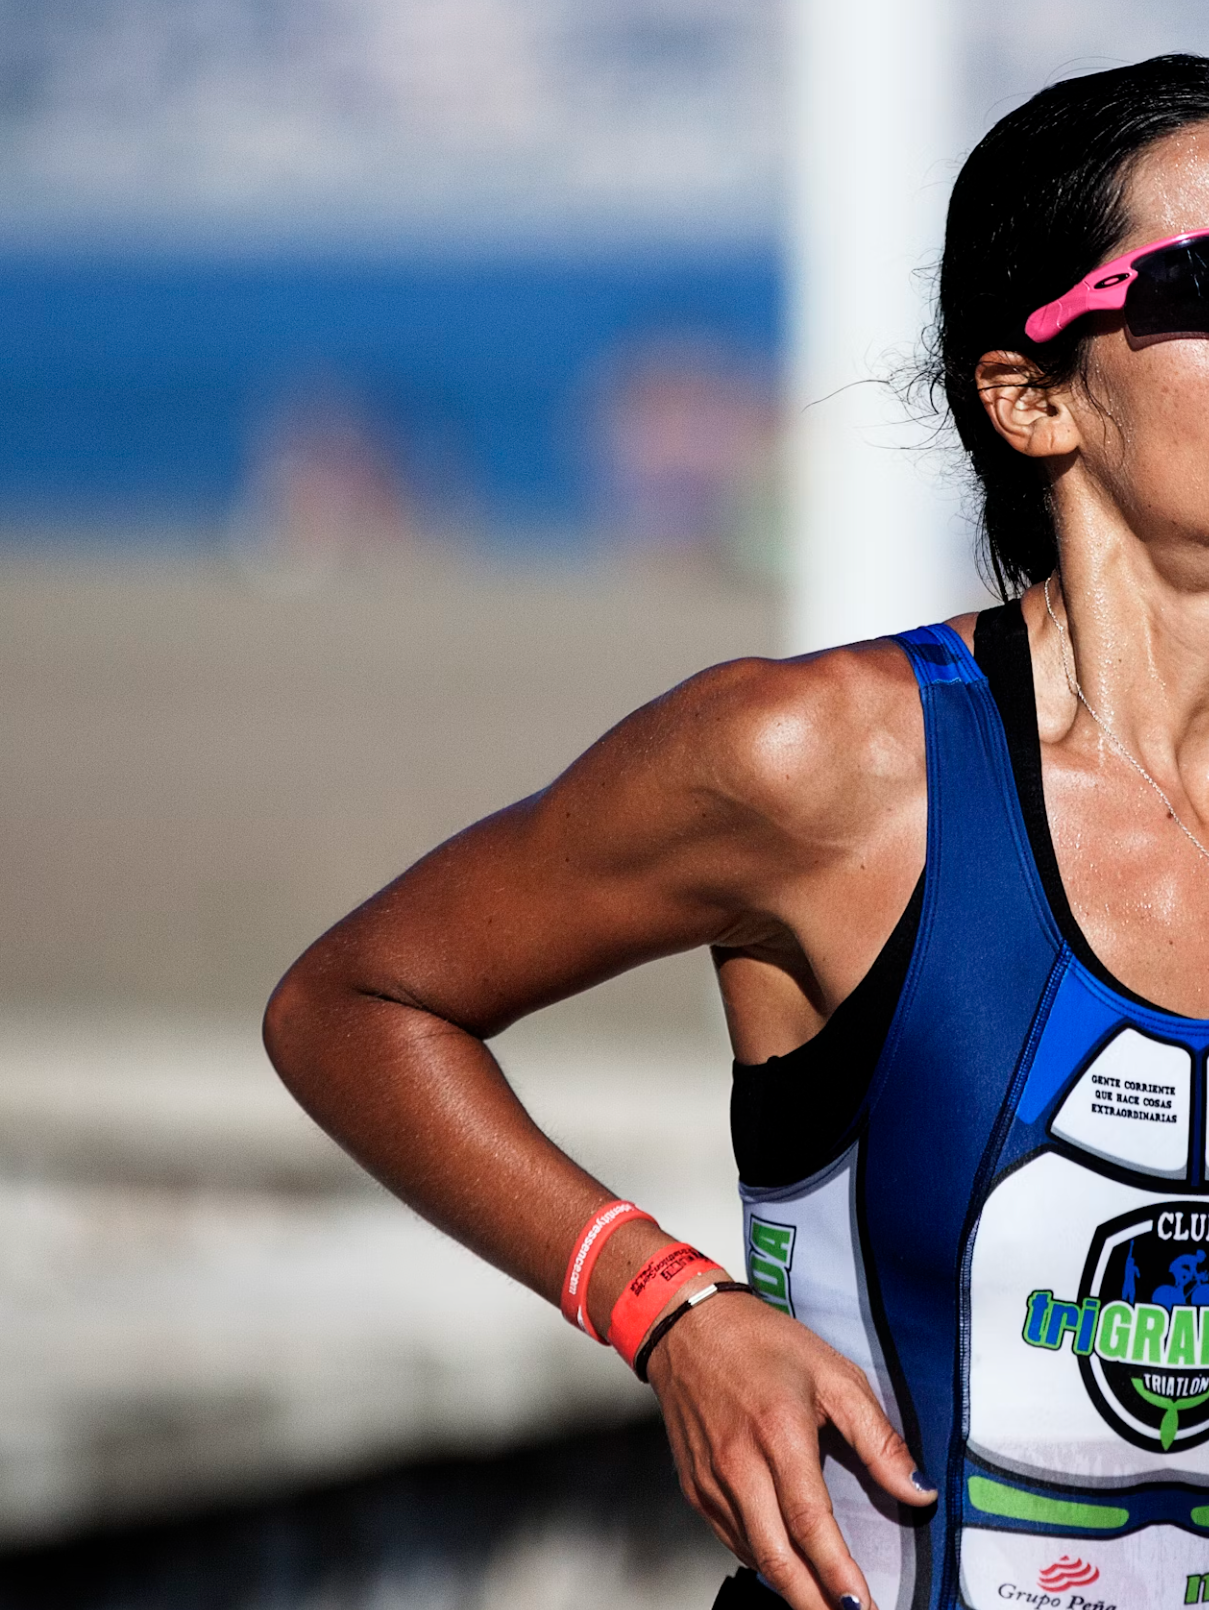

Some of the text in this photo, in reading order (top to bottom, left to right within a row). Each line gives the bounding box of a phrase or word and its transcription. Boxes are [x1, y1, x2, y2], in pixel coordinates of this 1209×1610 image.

[1091, 1074, 1176, 1096] GENTE CORRIENTE
[1095, 1089, 1172, 1109] QUE HACE COSAS
[1091, 1103, 1177, 1124] EXTRAORDINARIAS
[998, 1583, 1061, 1610] Grupo
